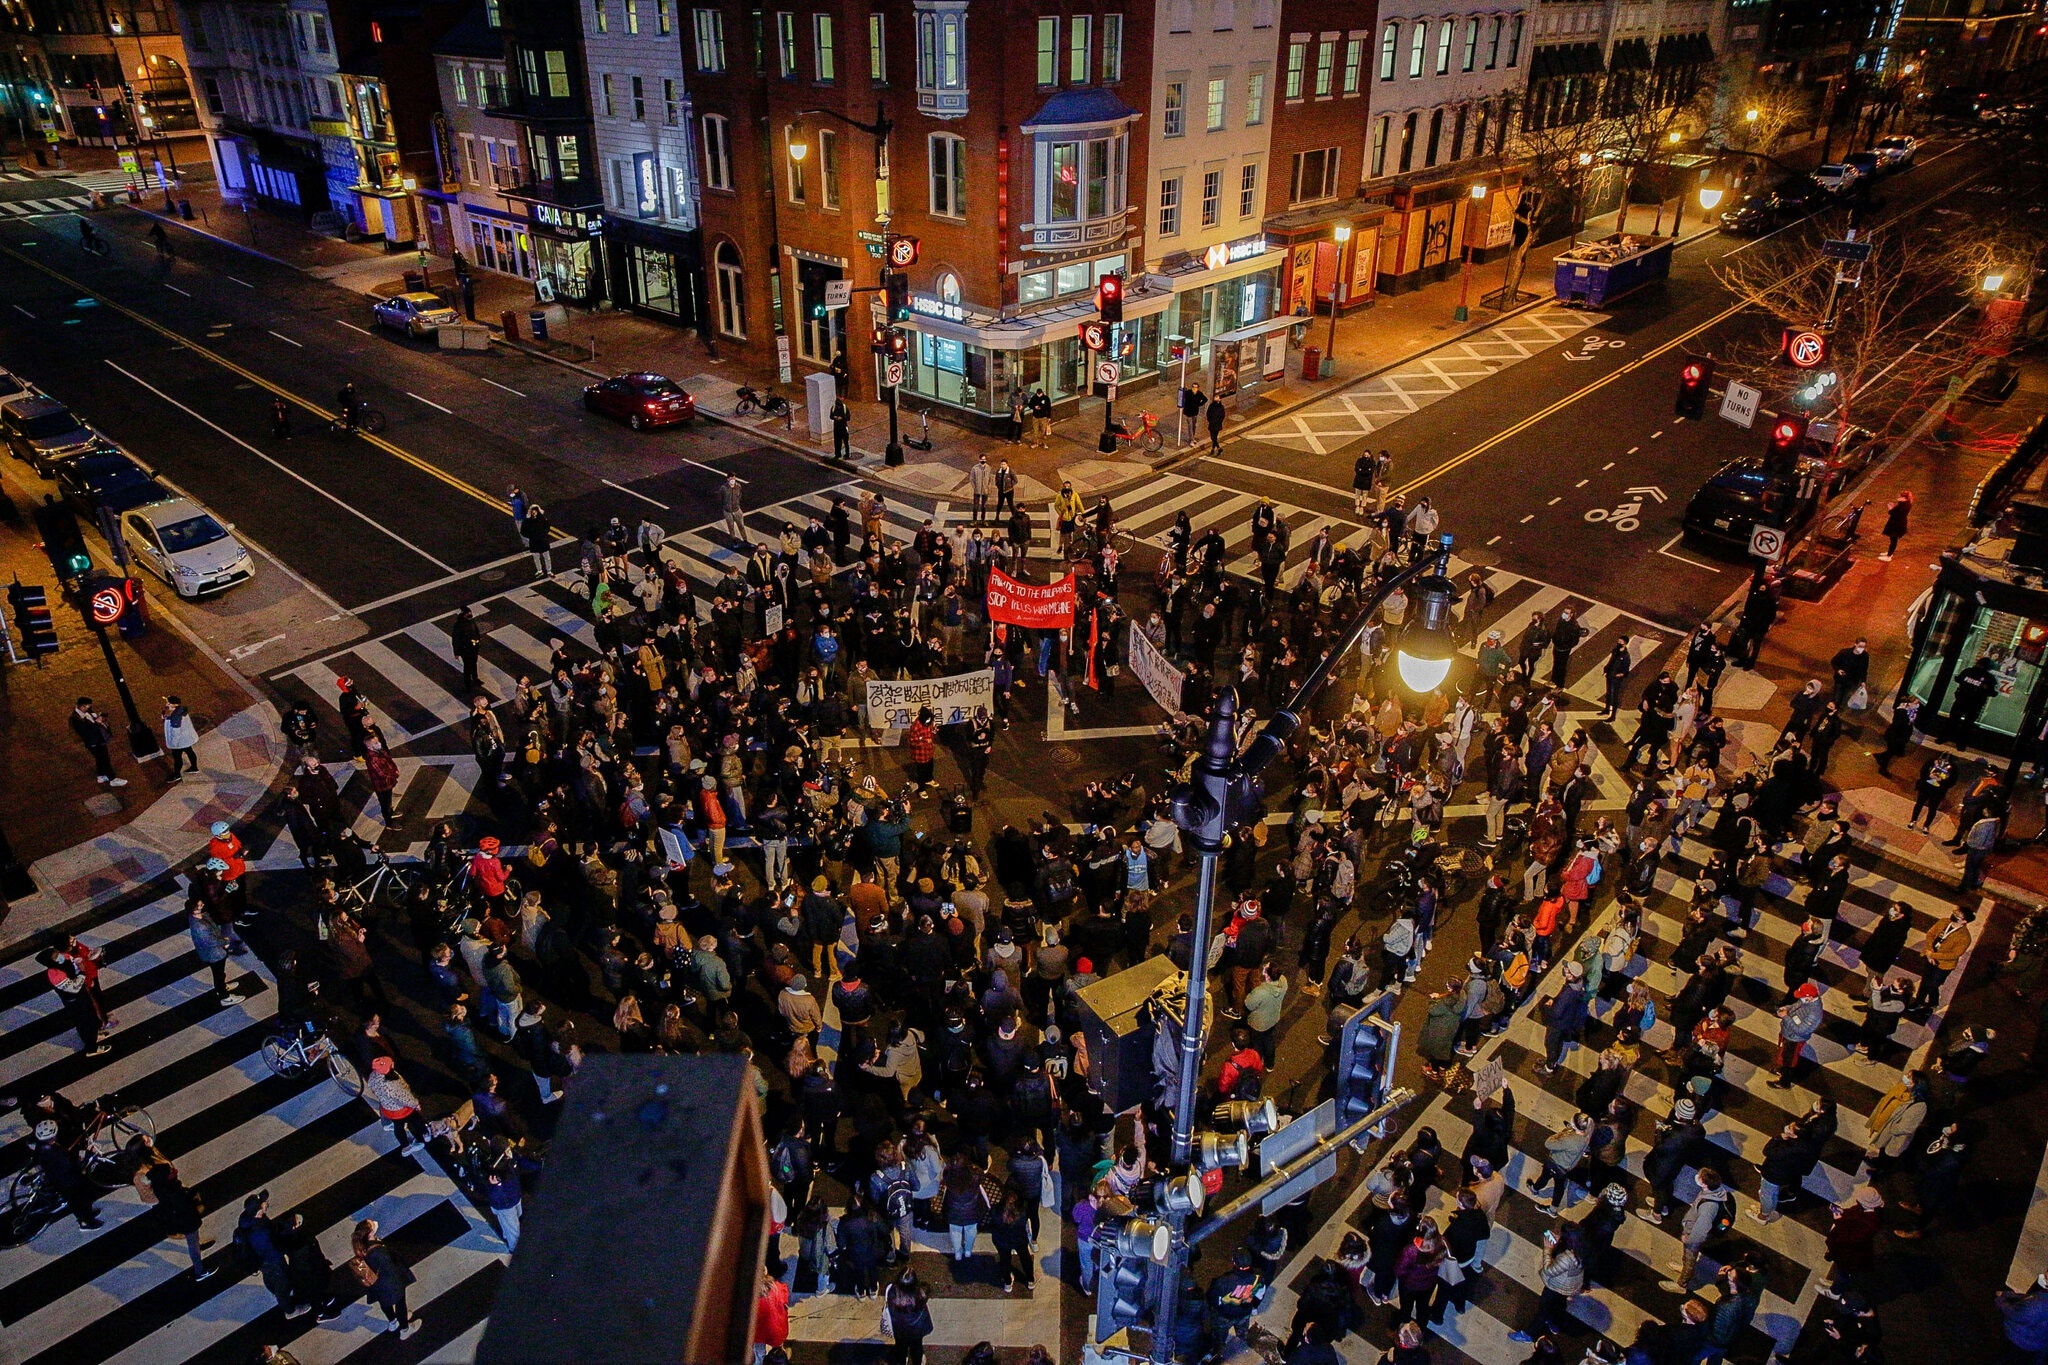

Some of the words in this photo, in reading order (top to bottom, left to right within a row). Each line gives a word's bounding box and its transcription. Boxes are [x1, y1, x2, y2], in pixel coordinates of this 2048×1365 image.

[537, 205, 562, 226] CAVA
[1737, 389, 1748, 400] NO
[1726, 400, 1751, 416] TURNS
[988, 592, 1007, 607] STOP
[1016, 586, 1026, 596] TO
[1027, 589, 1040, 598] THE
[869, 683, 903, 707] 경찰은
[904, 684, 931, 707] 범죄를
[1478, 1061, 1502, 1082] ASIAN
